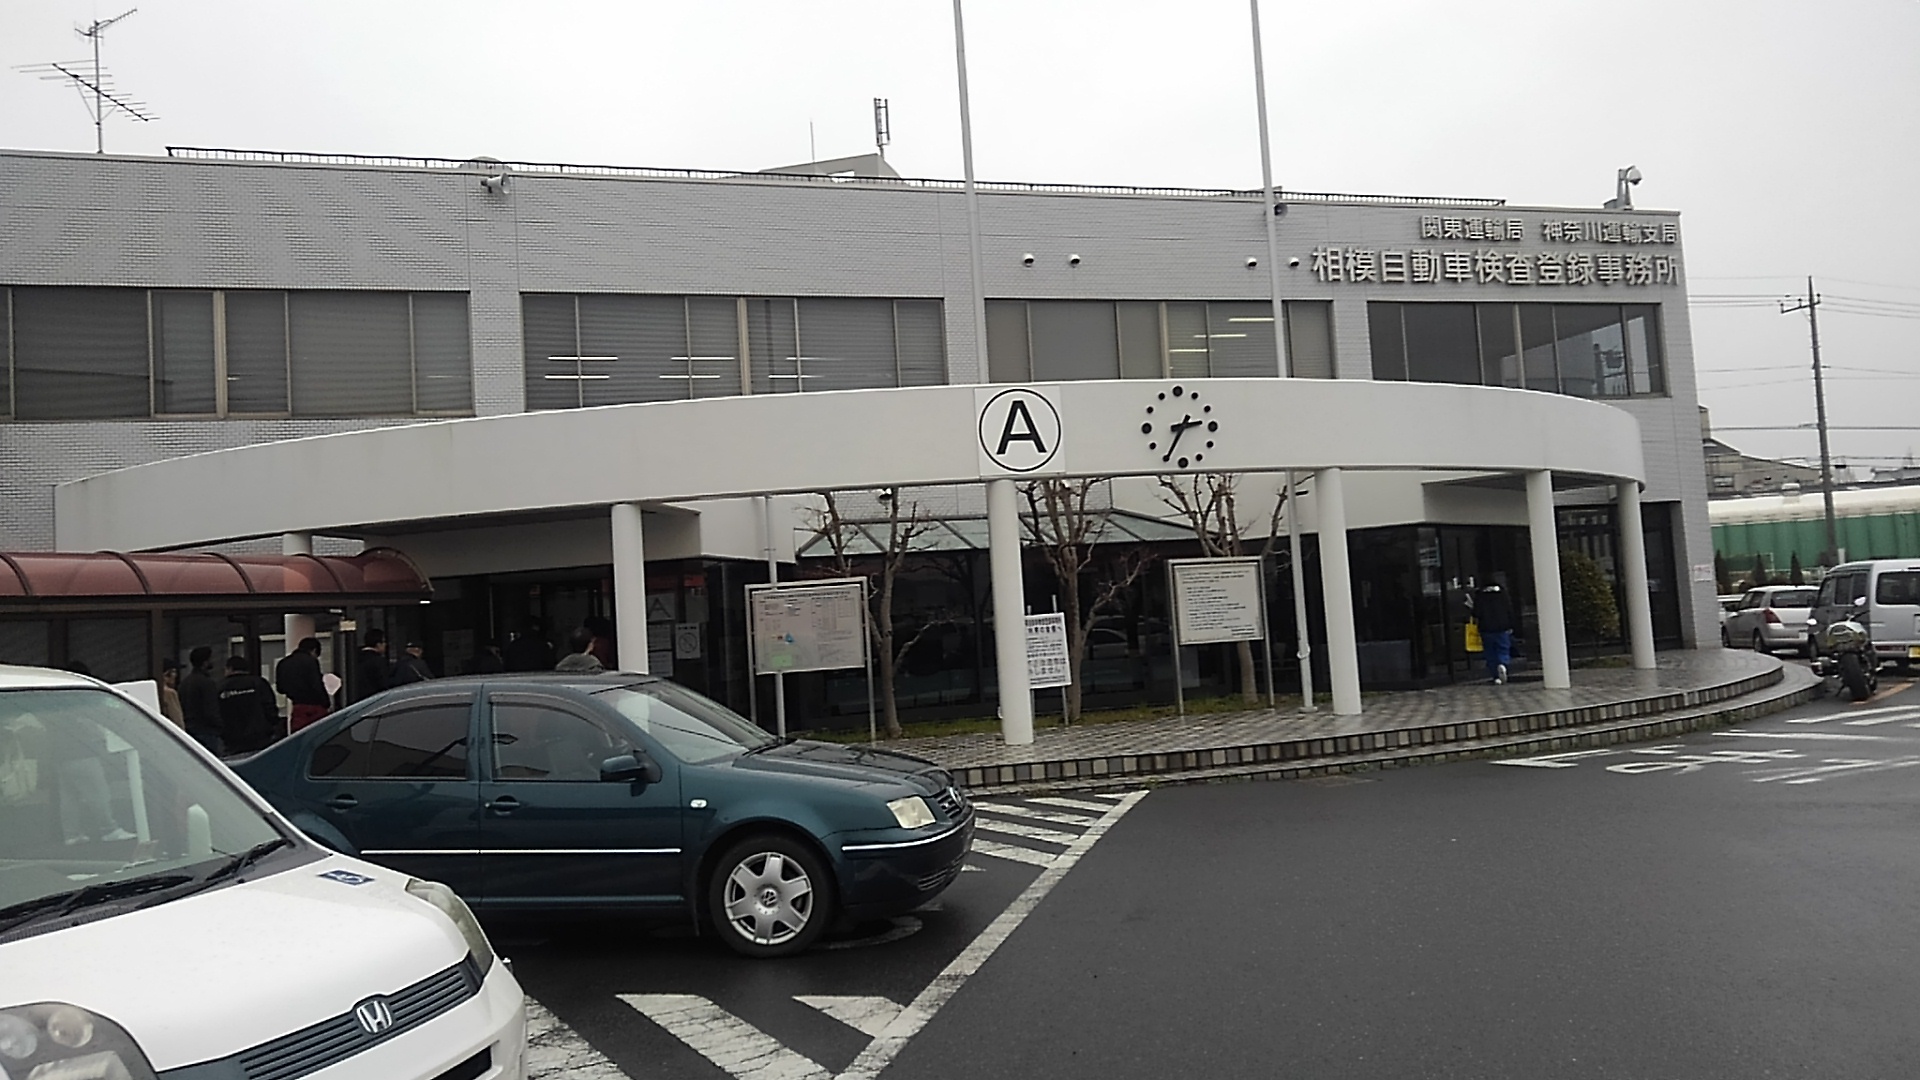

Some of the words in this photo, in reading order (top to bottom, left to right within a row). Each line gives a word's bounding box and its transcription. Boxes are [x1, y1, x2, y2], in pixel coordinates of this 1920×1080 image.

[1420, 215, 1524, 242] 関東運輸局
[1543, 219, 1678, 244] 神奈川運輸支局
[1312, 247, 1680, 286] 相模自動車検査登録事務所
[996, 399, 1048, 455] A
